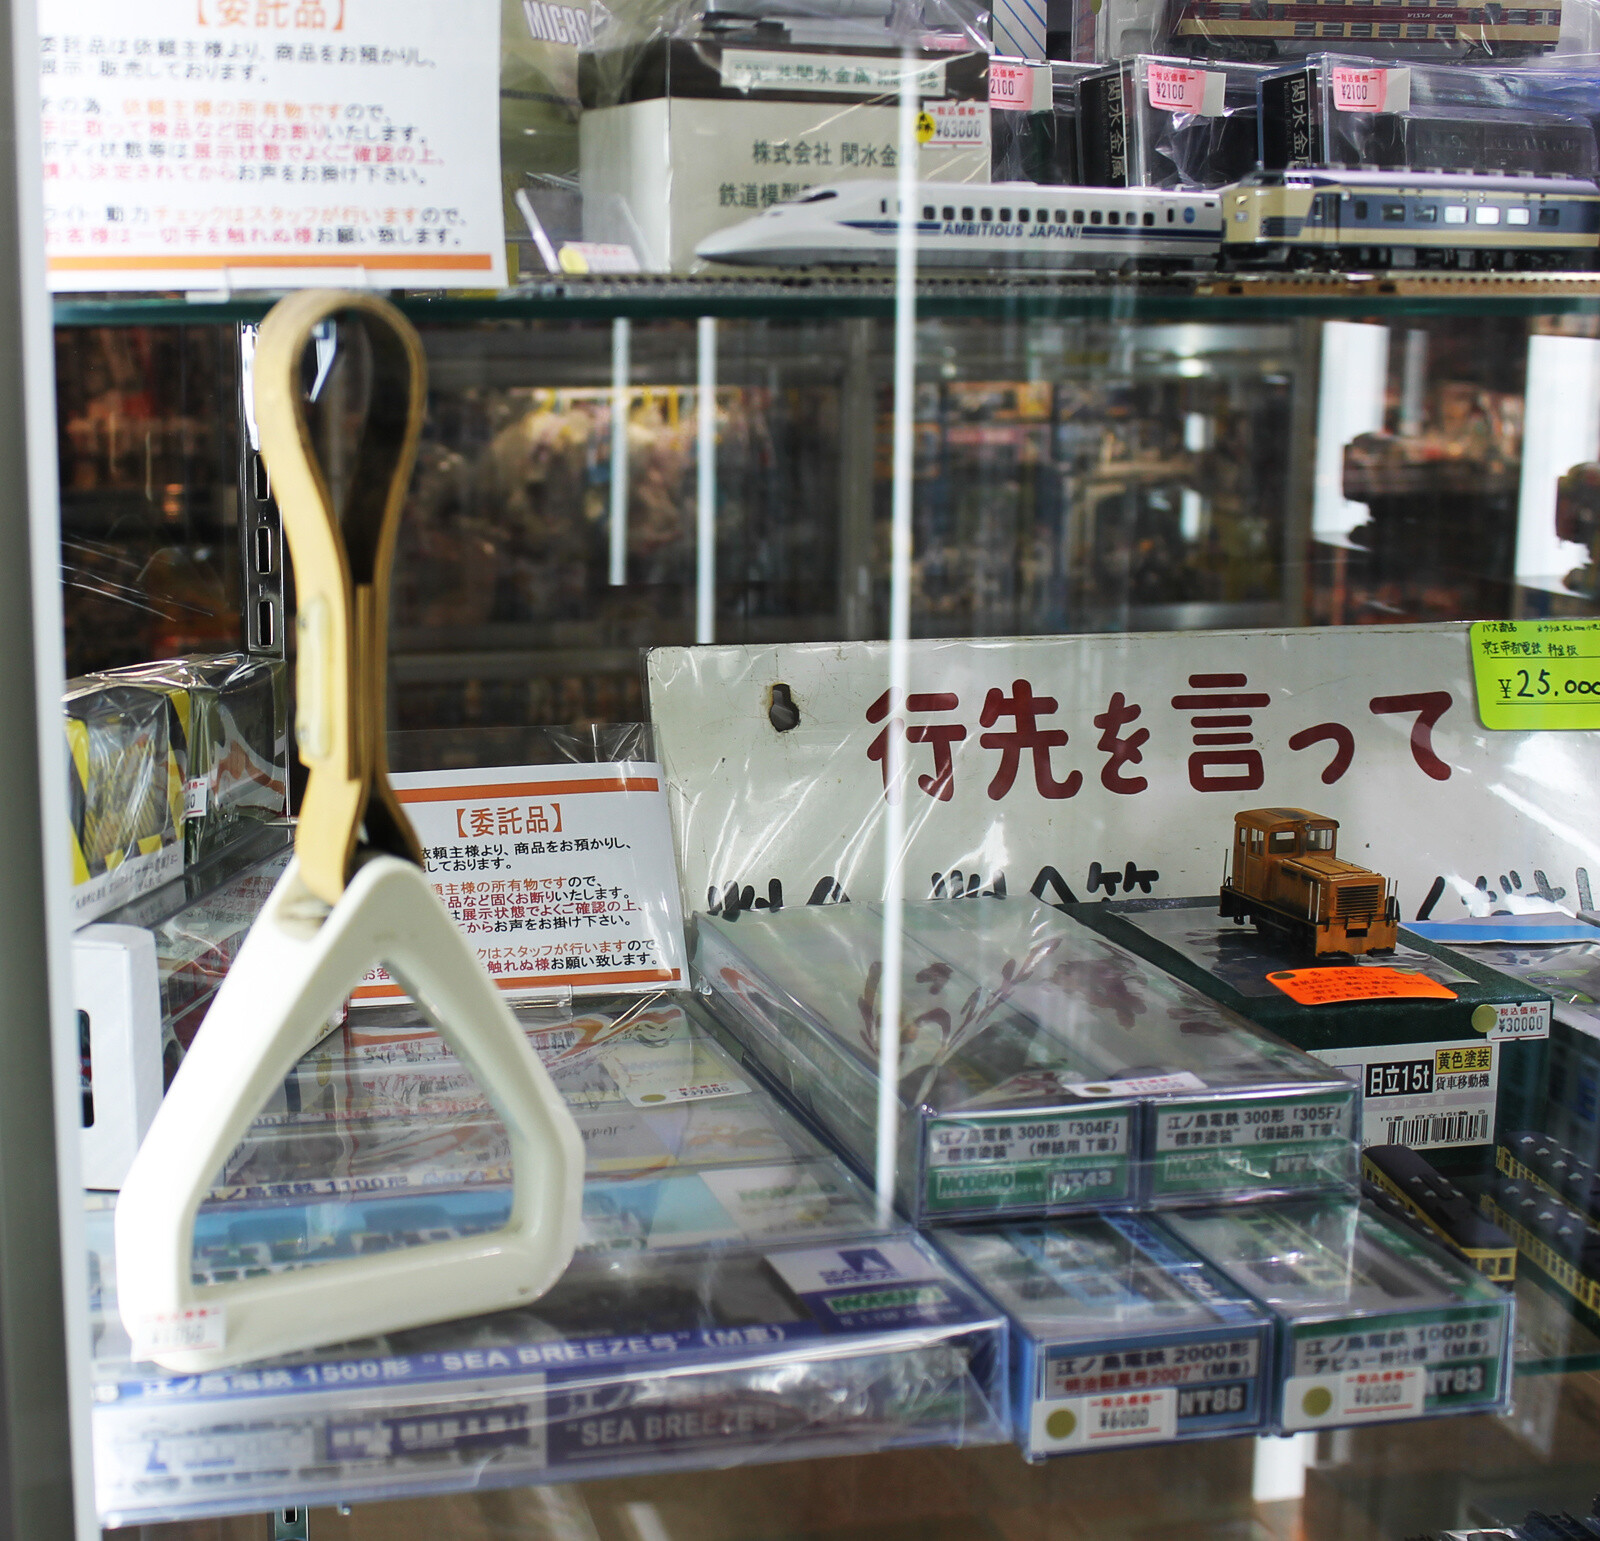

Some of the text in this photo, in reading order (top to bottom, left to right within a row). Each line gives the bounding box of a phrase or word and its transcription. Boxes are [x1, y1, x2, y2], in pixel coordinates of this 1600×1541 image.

[1156, 82, 1184, 100] ¥2100
[1342, 84, 1368, 100] ¥2100
[753, 140, 832, 166] 株式会社
[719, 182, 812, 209] 鉄道模型
[944, 222, 1082, 239] AMBITIOUS JAPAN!
[866, 673, 1453, 805] 行先を言って
[456, 803, 563, 838] 【委託品】
[423, 856, 512, 874] しております。
[440, 887, 631, 908] 品など固くお断りいたします。
[1500, 1006, 1538, 1016] 税込価格
[1498, 1015, 1543, 1033] ¥30000
[1438, 1049, 1490, 1070] 黄色塗装
[1370, 1064, 1430, 1095] 日立15t
[1435, 1073, 1490, 1091] 貨車移動機
[1244, 1109, 1285, 1125] 300形
[1018, 1124, 1060, 1140] 300形
[1173, 1342, 1249, 1363] 2000形
[1179, 1386, 1243, 1417] NT86
